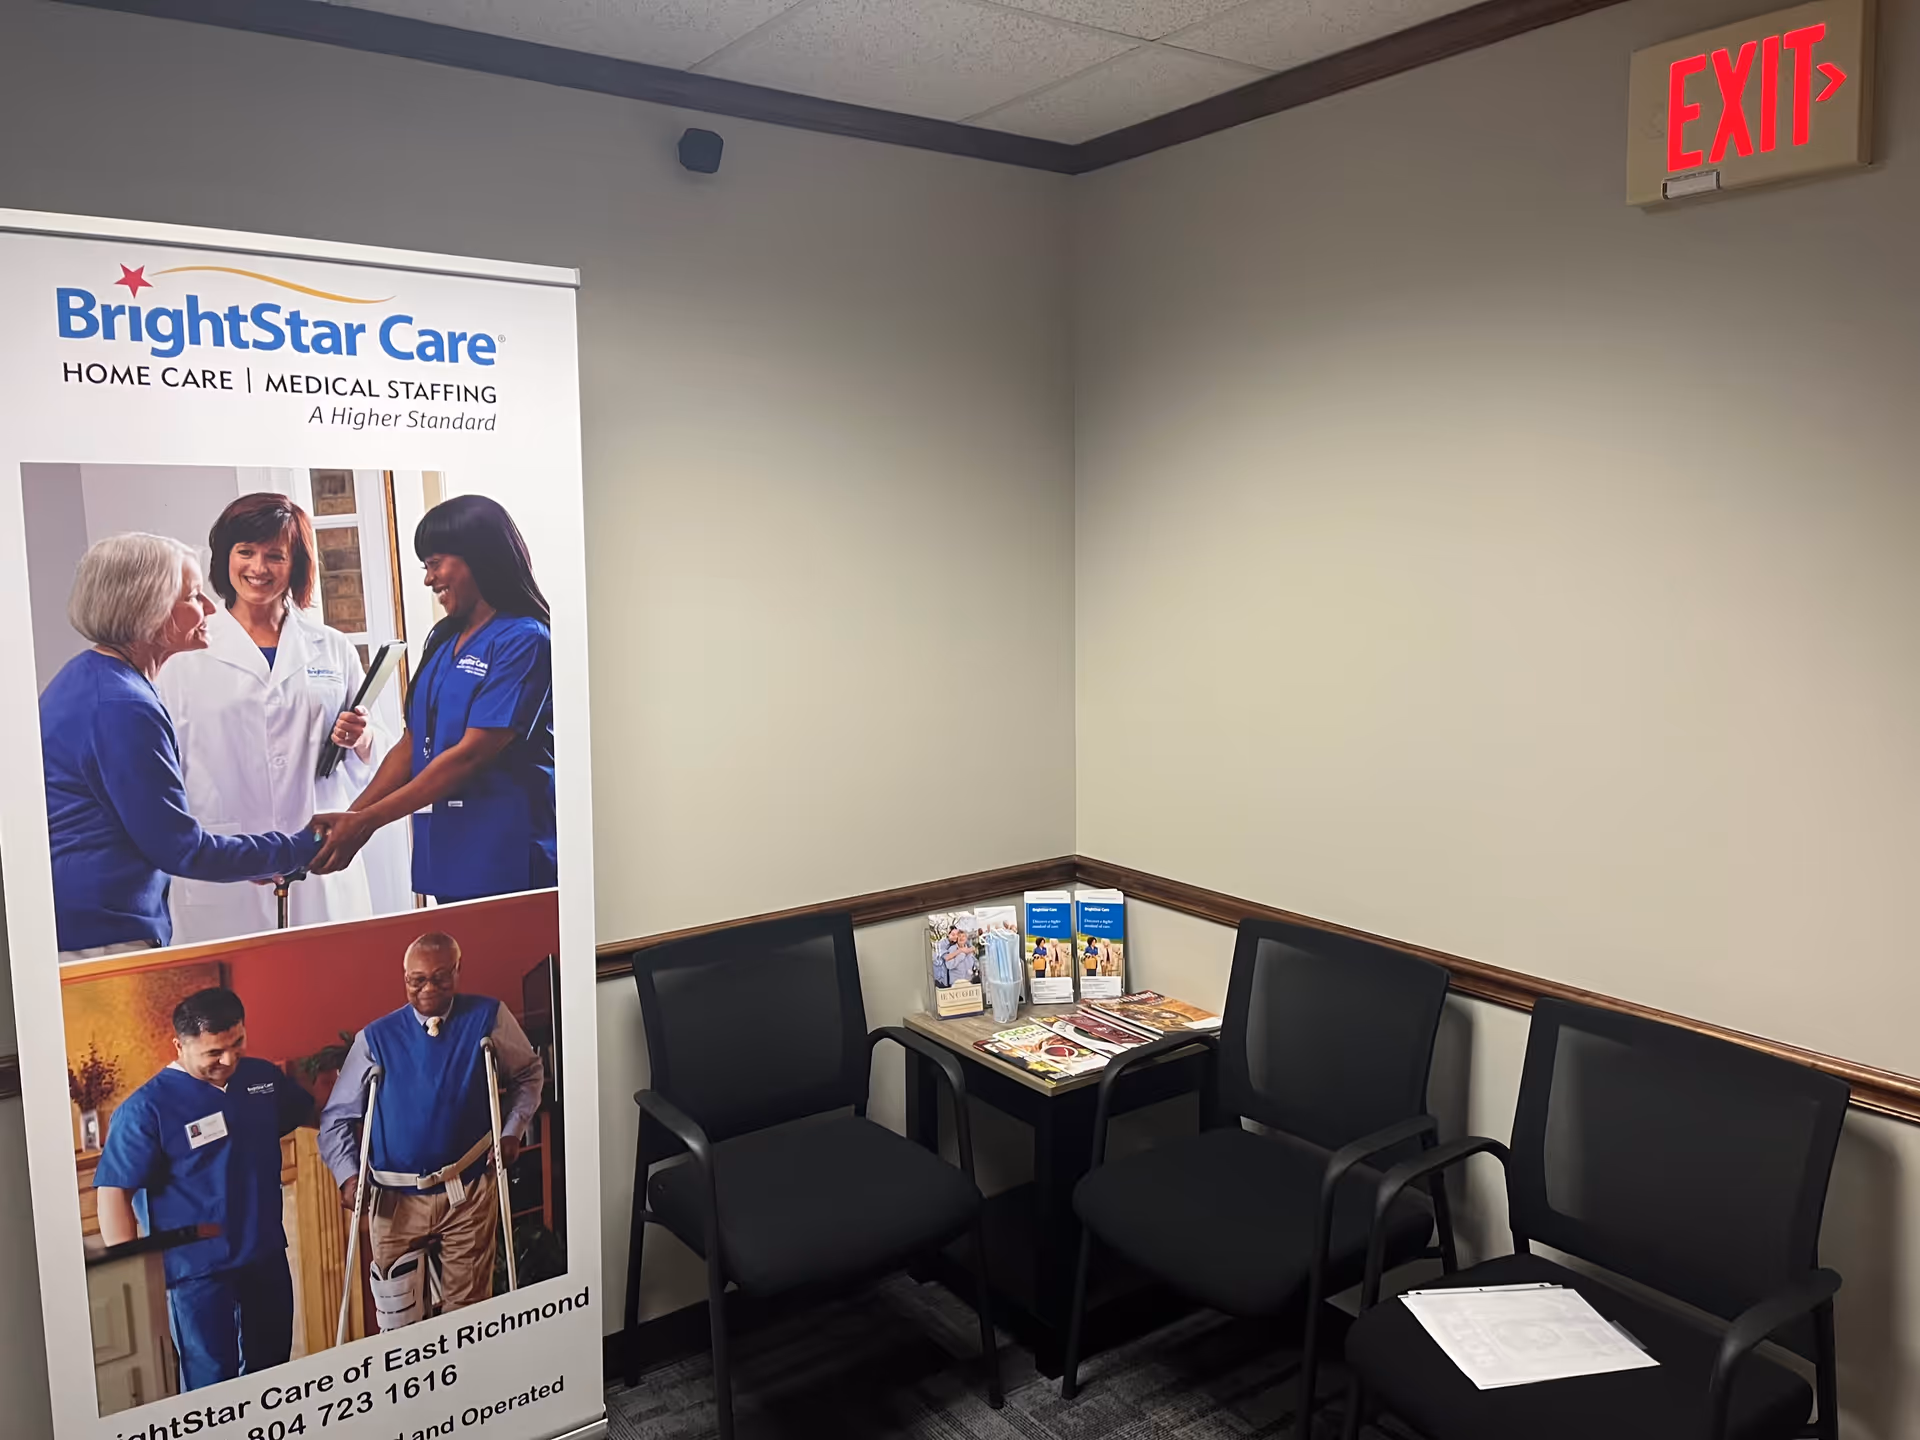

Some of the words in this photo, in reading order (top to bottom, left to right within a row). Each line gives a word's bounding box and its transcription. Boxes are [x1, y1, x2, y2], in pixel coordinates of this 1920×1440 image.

[1667, 22, 1826, 173] EXIT
[56, 287, 366, 358] BrightStar
[63, 362, 151, 386] HOME
[161, 366, 234, 390] CARE
[265, 373, 380, 398] MEDICAL
[387, 380, 497, 404] STAFFING
[308, 406, 323, 424] A
[331, 406, 402, 431] Higher
[406, 410, 496, 431] Standard
[260, 1375, 334, 1410] Care
[343, 1355, 374, 1384] of
[384, 1334, 450, 1373] East
[456, 1285, 589, 1350] Richmond
[247, 1413, 307, 1440] 804
[317, 1391, 374, 1427] 723
[384, 1364, 458, 1405] 1616
[411, 1415, 455, 1440] and
[461, 1374, 564, 1427] Operated
